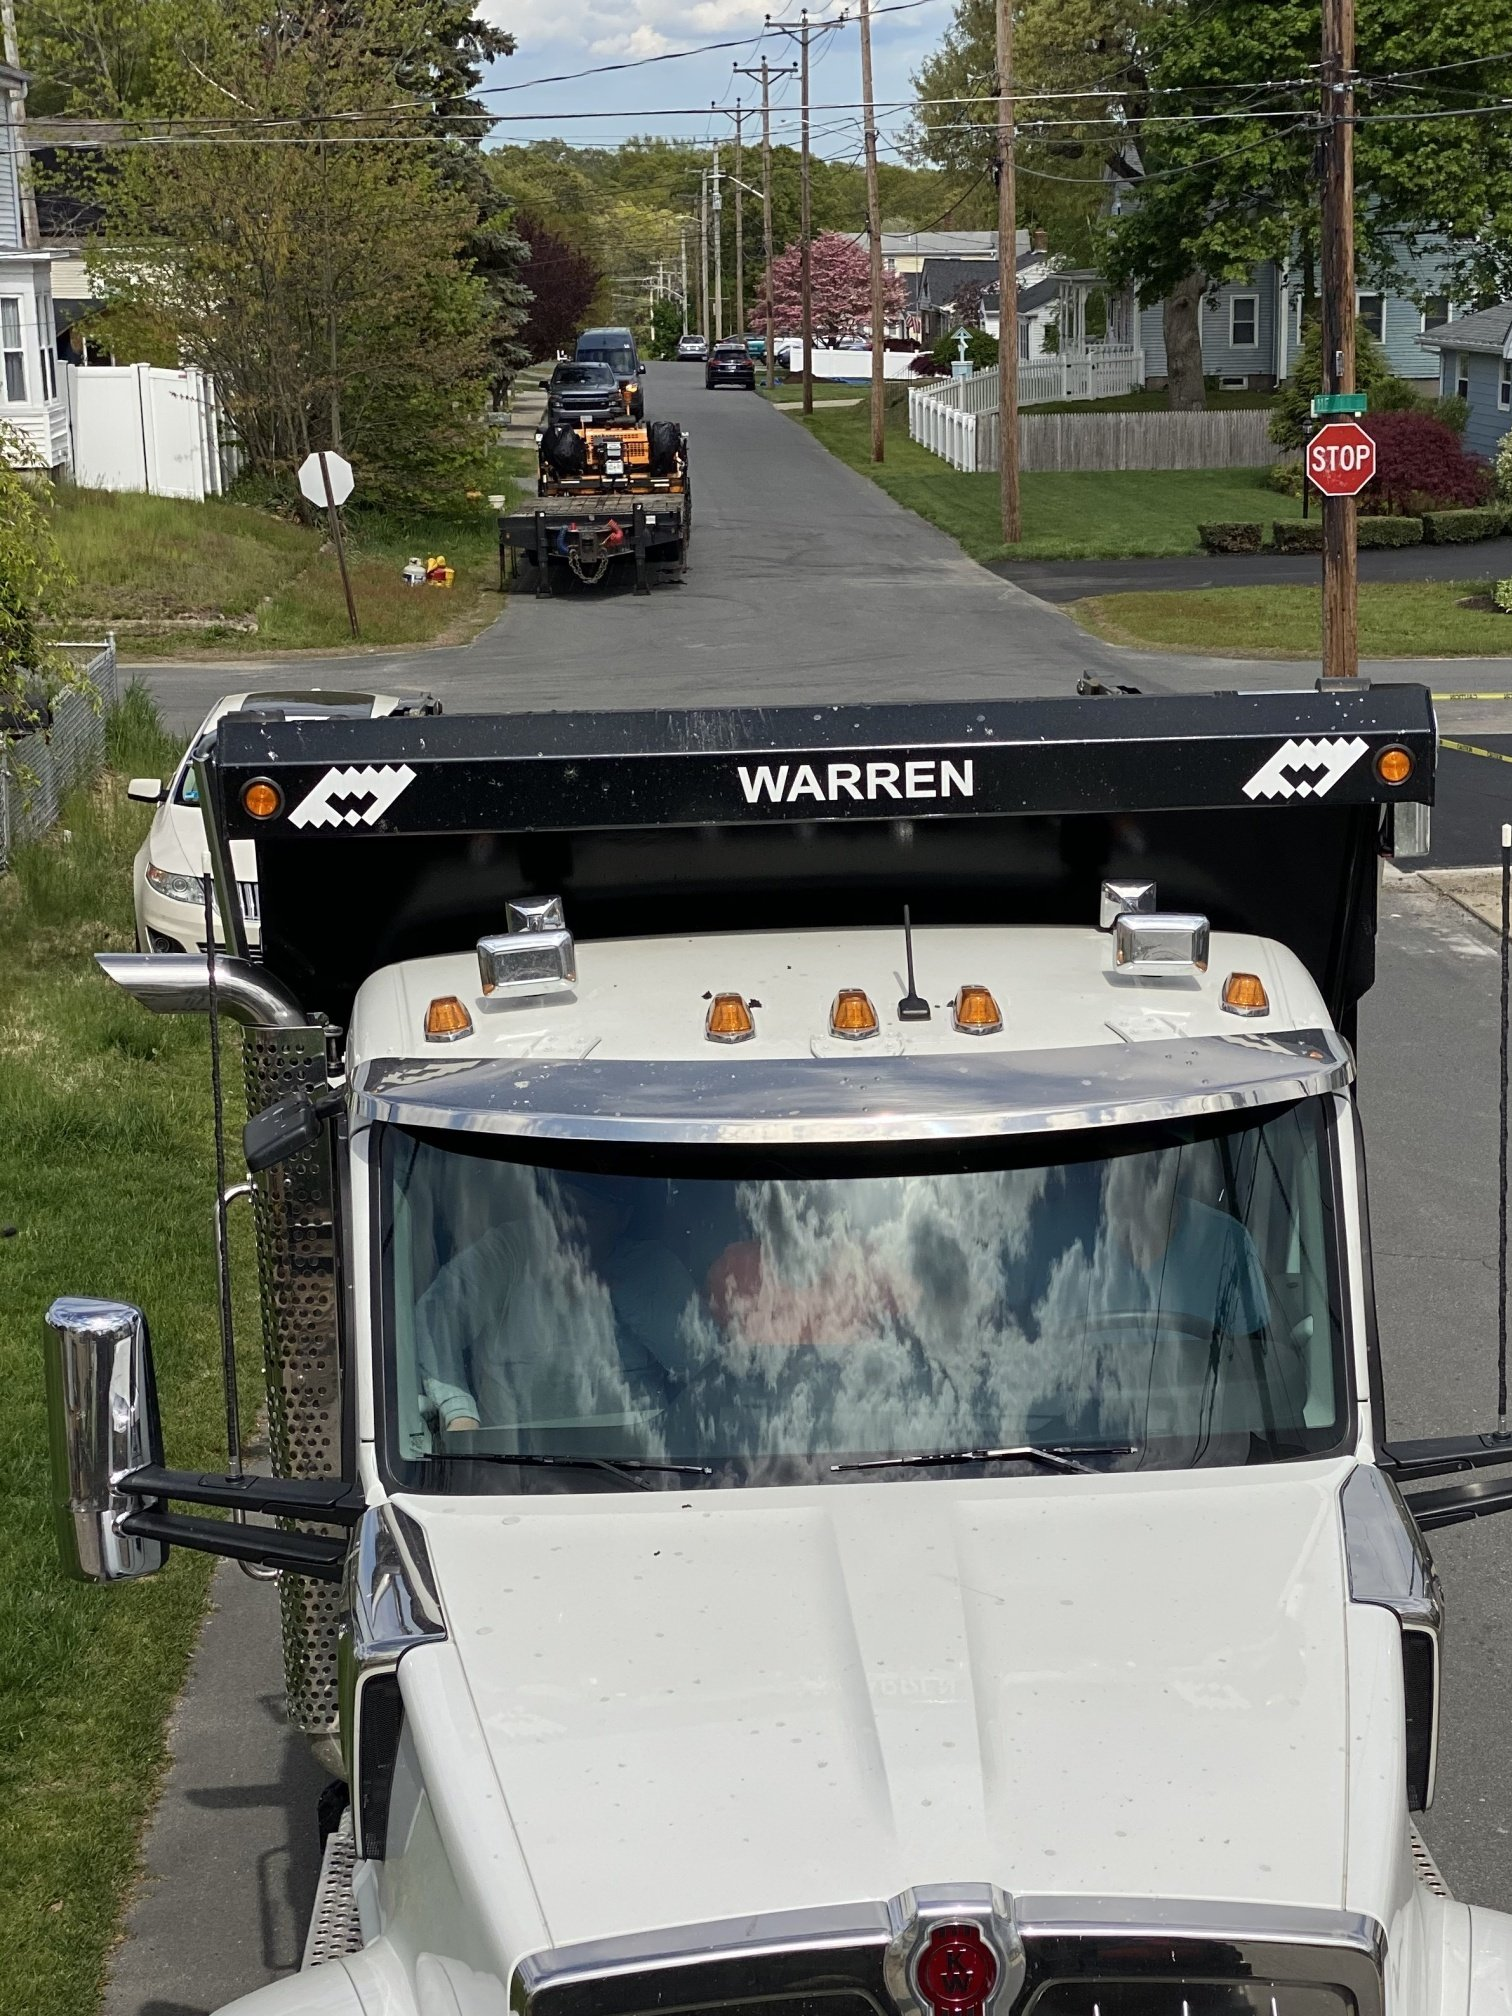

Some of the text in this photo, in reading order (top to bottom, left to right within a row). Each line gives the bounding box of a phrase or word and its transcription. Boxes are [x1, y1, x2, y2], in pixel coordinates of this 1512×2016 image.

[1312, 445, 1370, 472] STOP
[737, 760, 974, 803] WARREN
[946, 1949, 967, 1971] K
[940, 1970, 974, 1994] W
